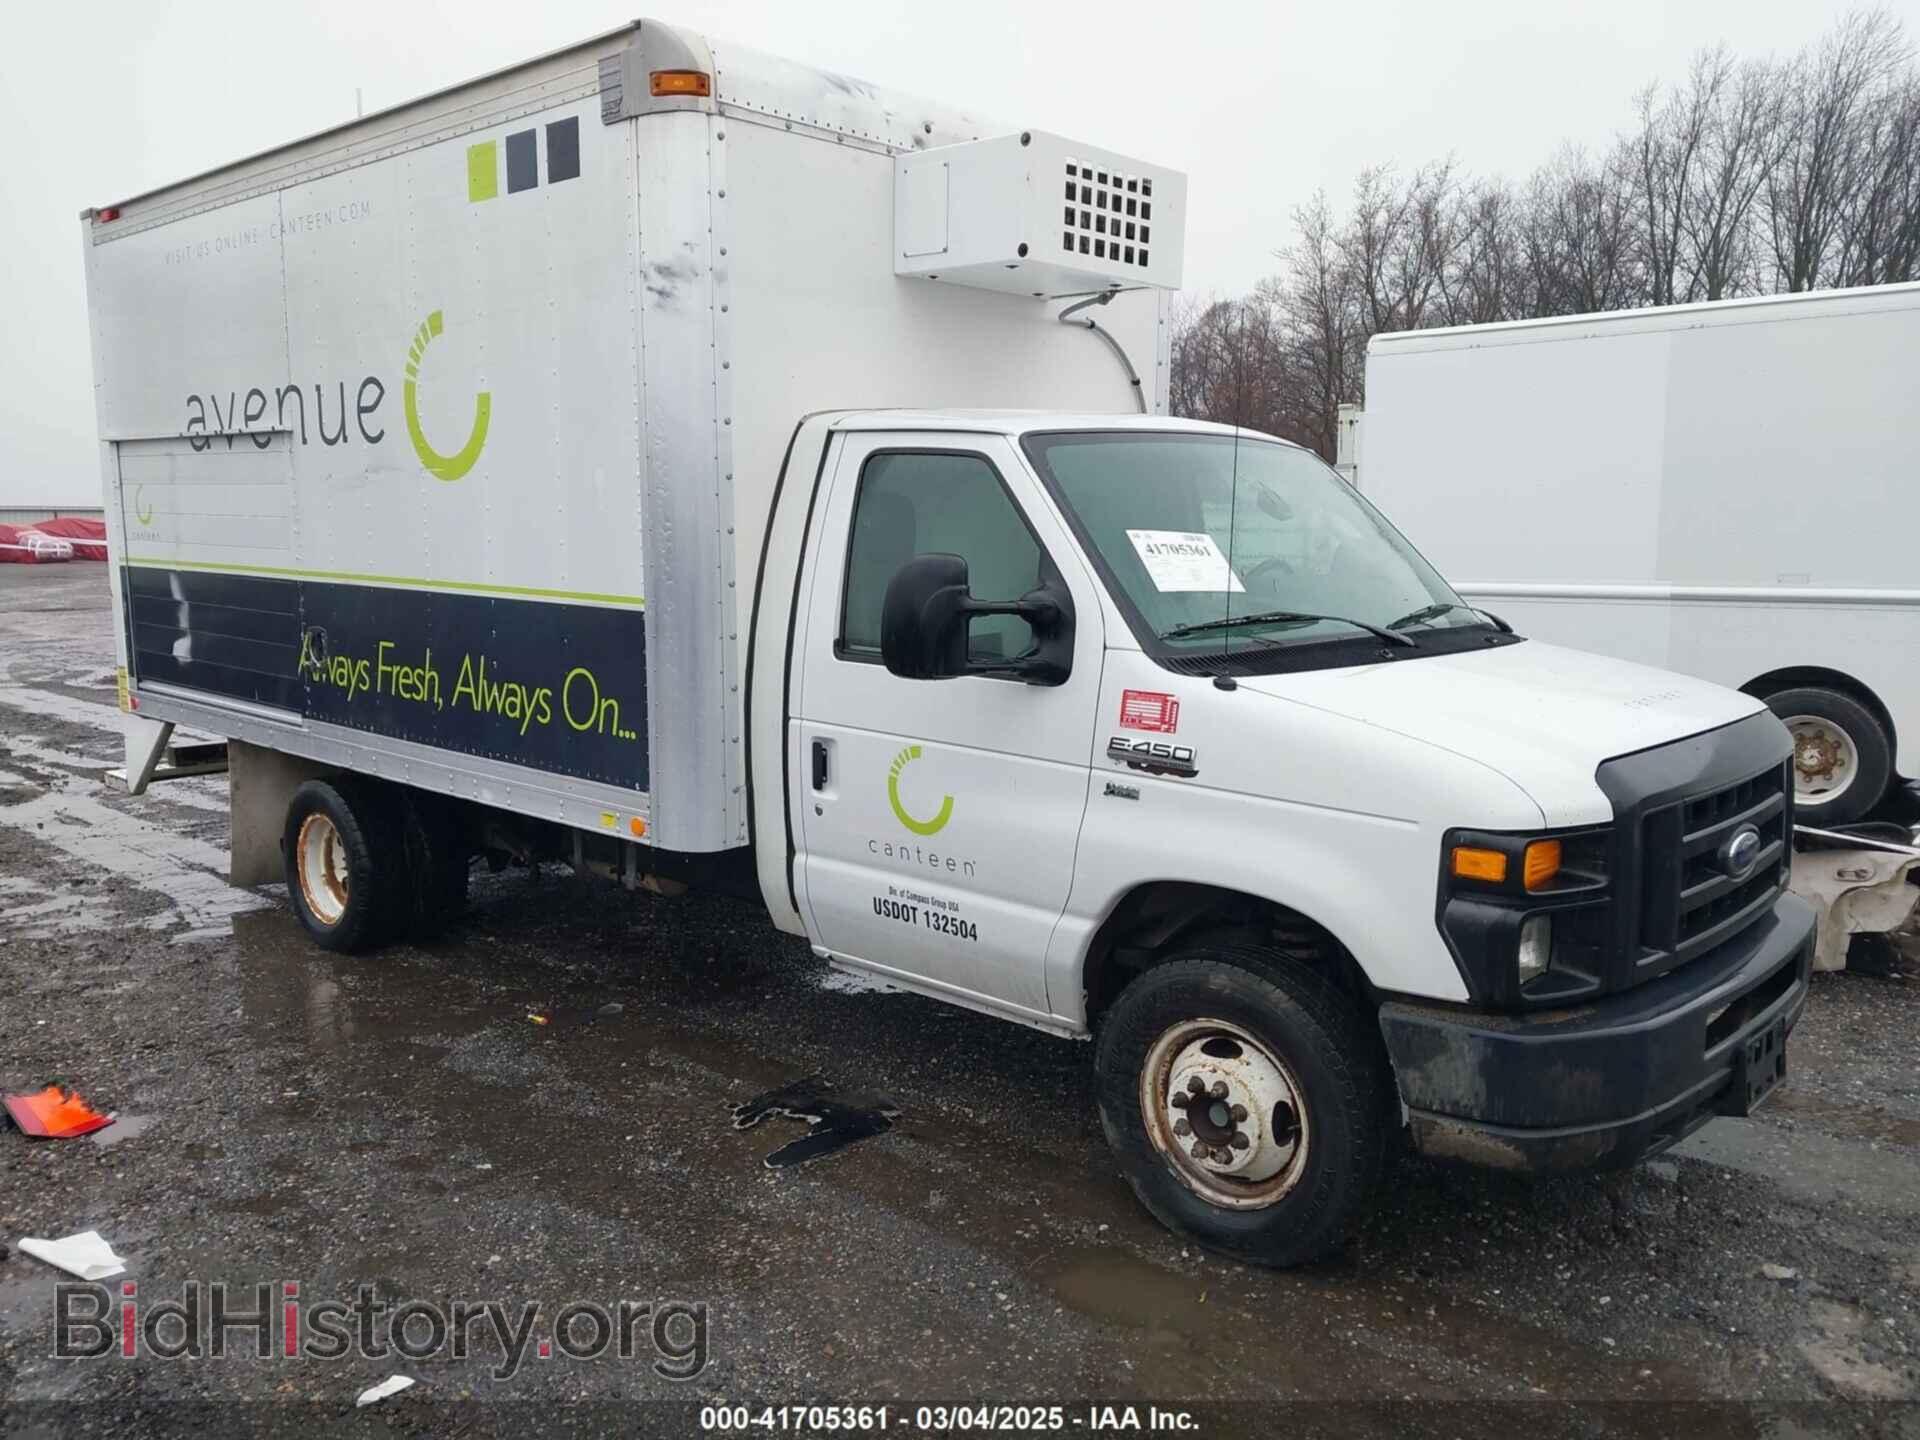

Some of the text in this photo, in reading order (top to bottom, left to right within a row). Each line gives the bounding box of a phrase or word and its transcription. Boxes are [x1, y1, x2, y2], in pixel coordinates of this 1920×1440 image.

[164, 246, 191, 265] VISIT
[269, 201, 370, 240] CANTEENCOM
[186, 376, 385, 452] avenue
[1145, 543, 1211, 557] 41705361
[298, 630, 637, 740] Aways Fresh, Always On...
[868, 839, 976, 877] canteen
[873, 896, 978, 942] USDOT 132504
[899, 889, 906, 898] of
[906, 890, 930, 904] Compass
[931, 896, 947, 910] Group
[948, 901, 960, 912] USA
